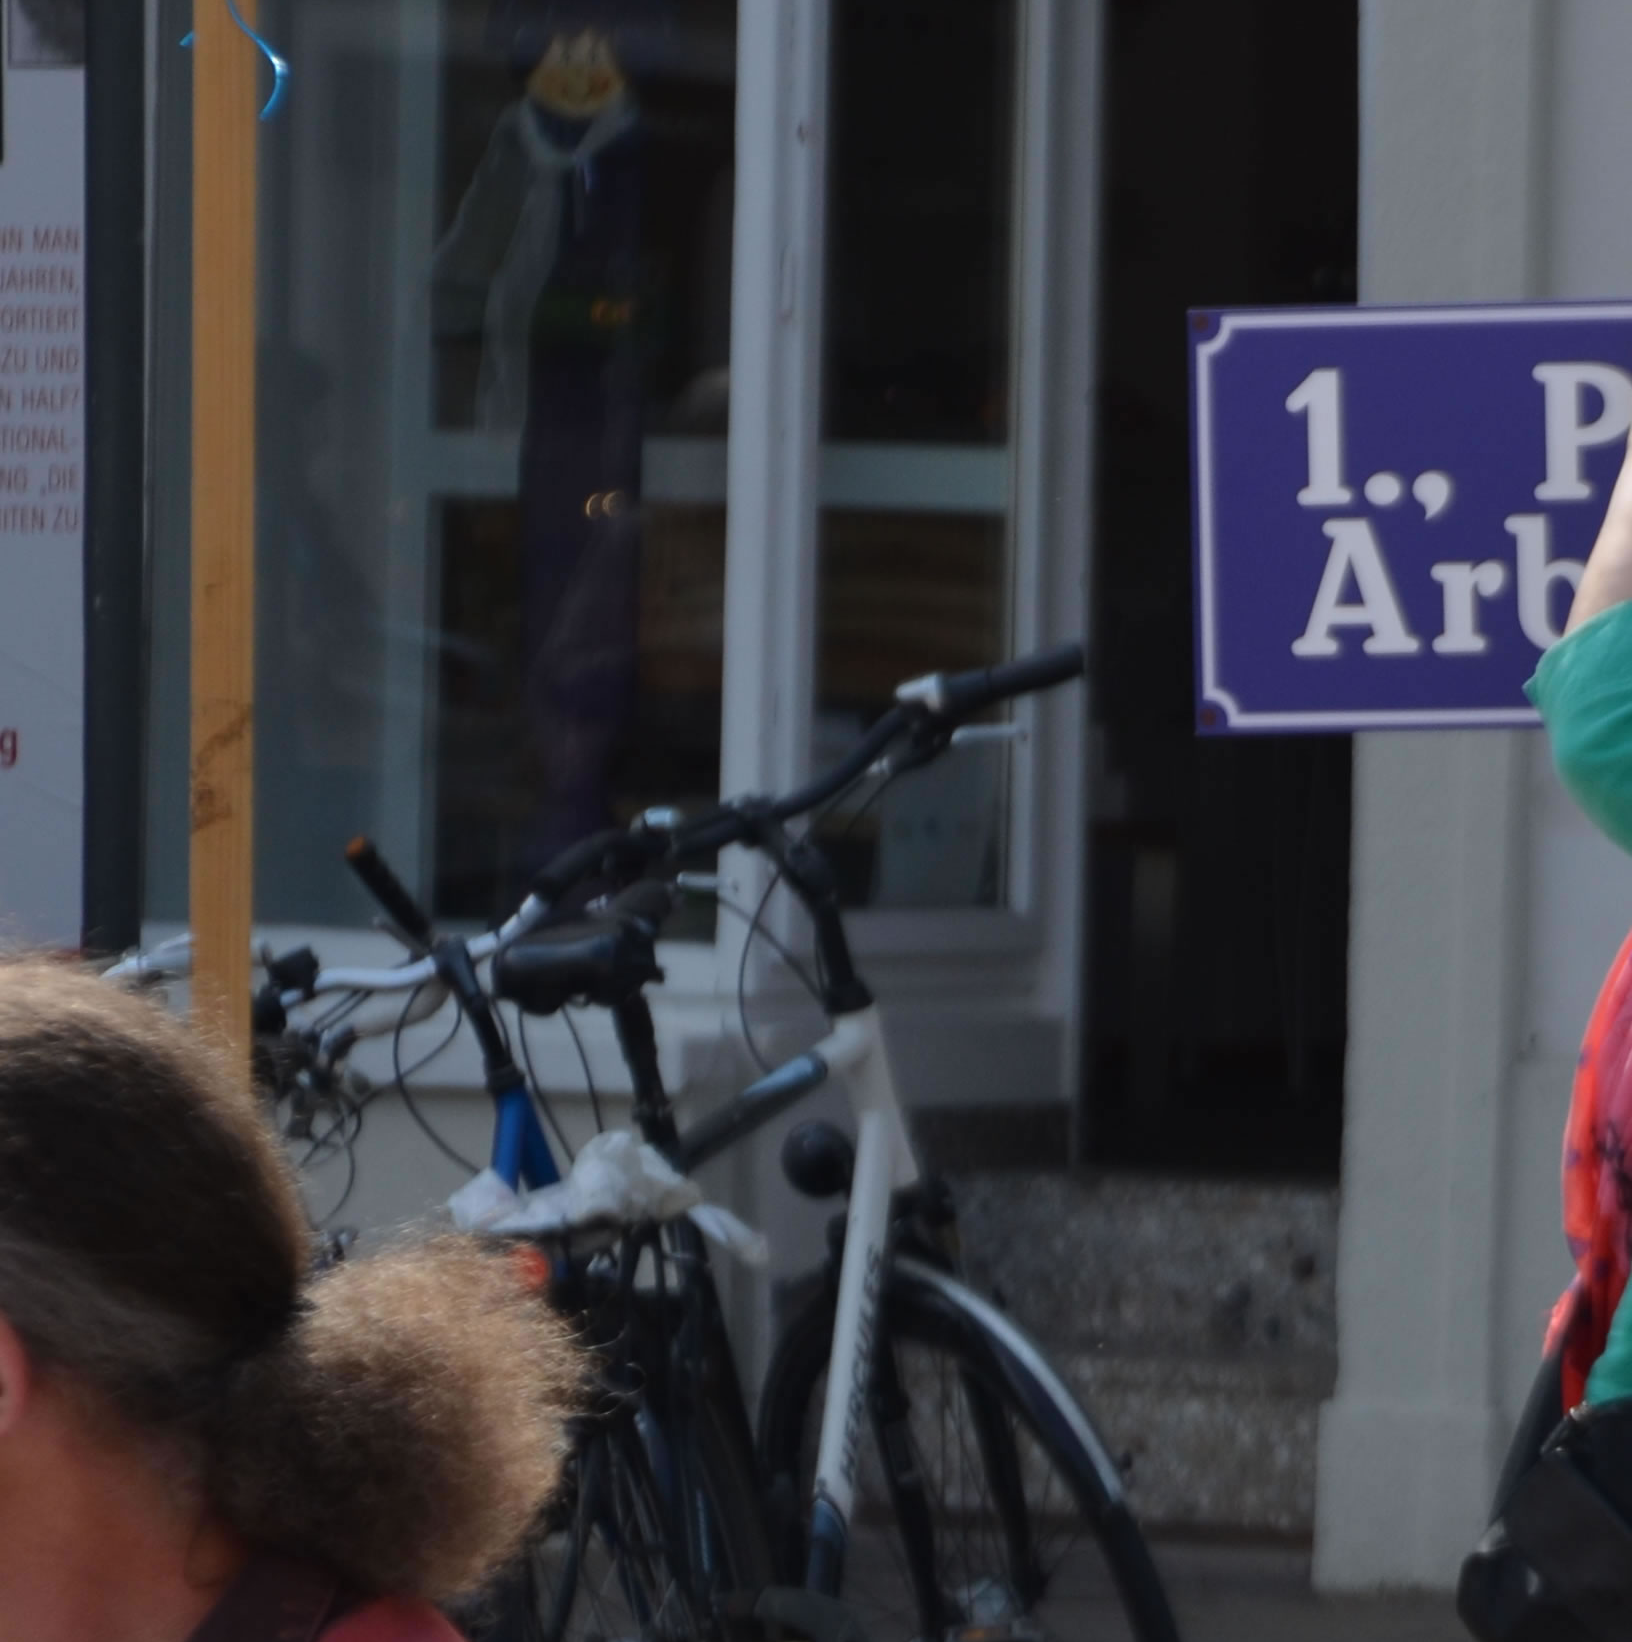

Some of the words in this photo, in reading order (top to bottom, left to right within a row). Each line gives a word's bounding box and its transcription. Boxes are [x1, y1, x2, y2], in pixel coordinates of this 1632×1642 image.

[33, 224, 80, 254] MAN
[36, 343, 79, 374] UND
[22, 384, 79, 414] HALF?
[1284, 365, 1453, 522] 1.,
[52, 503, 78, 534] ZU
